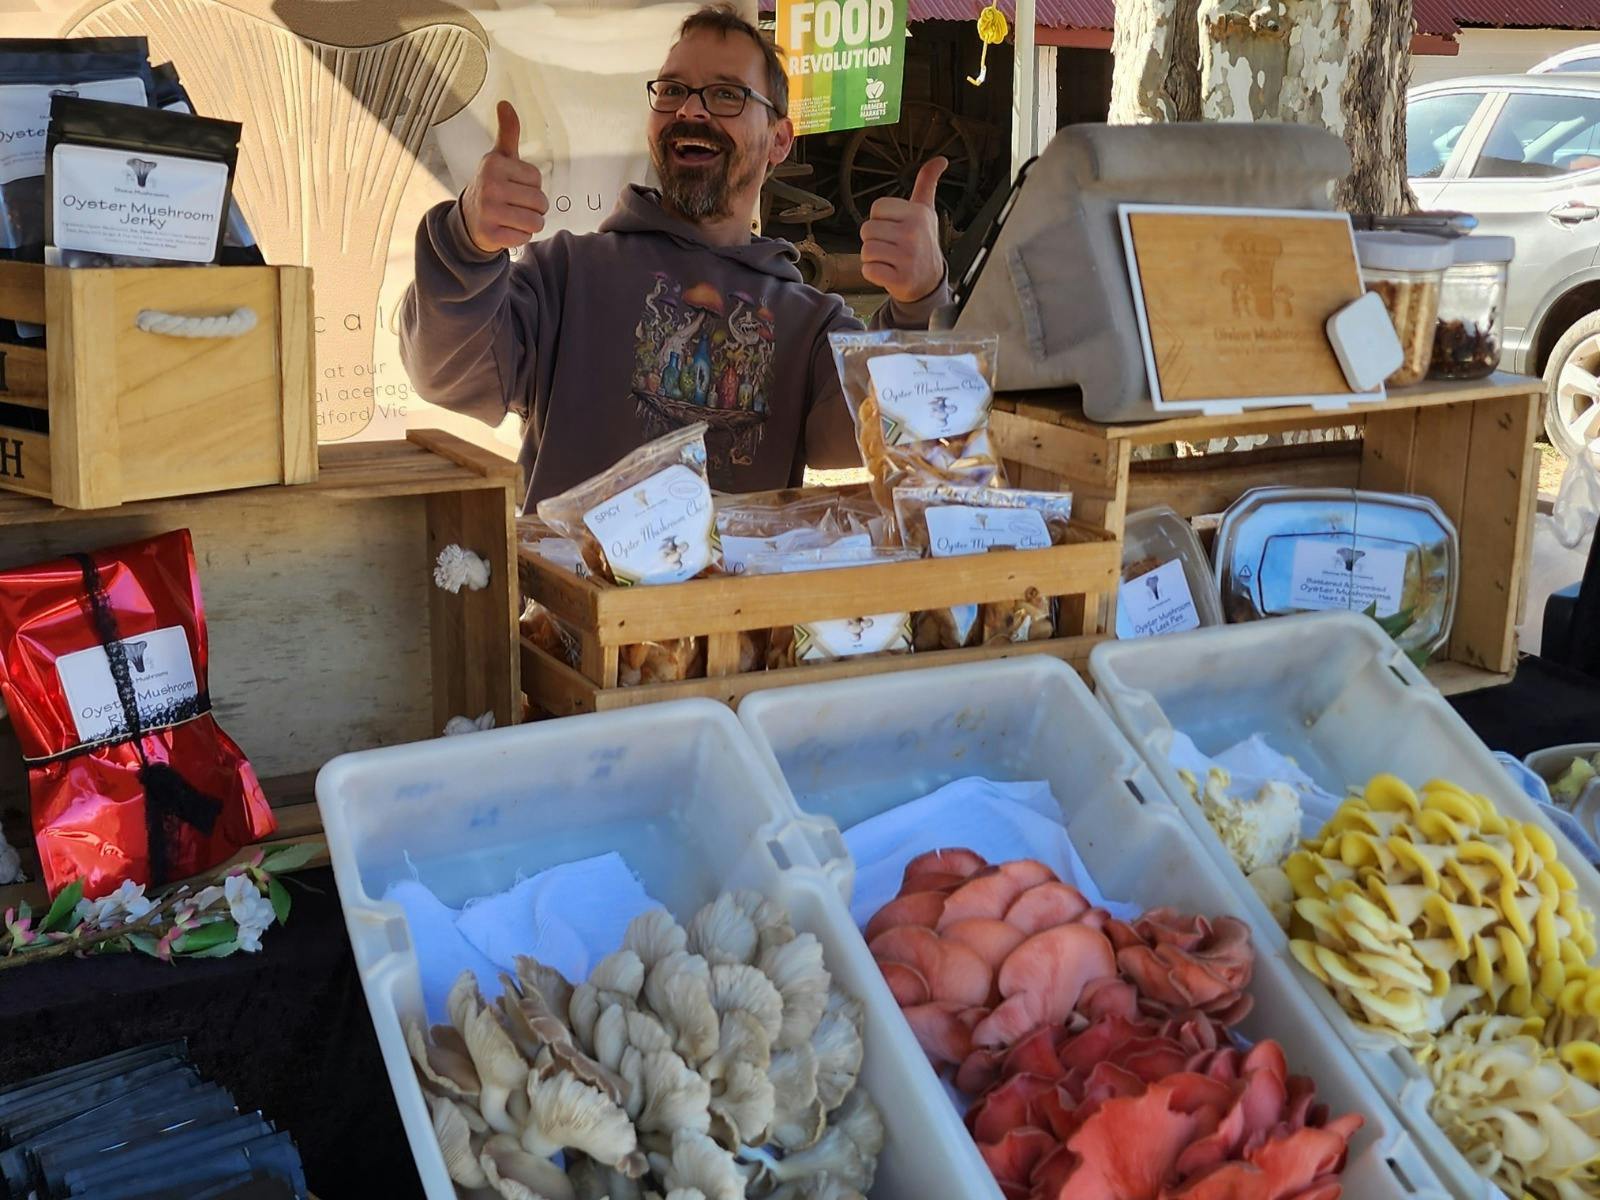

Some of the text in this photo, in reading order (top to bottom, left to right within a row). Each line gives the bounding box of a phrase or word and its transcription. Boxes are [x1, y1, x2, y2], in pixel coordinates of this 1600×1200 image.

[790, 0, 894, 49] FOOD
[789, 46, 892, 75] REVOLUTION
[860, 109, 886, 118] MARKETS
[0, 128, 46, 143] yste
[63, 194, 214, 222] Oyster Mushroom
[119, 213, 167, 230] Jerky
[324, 362, 387, 378] at our
[882, 387, 913, 403] Oyster
[378, 402, 408, 419] Vic
[595, 504, 621, 523] SPICY
[612, 540, 640, 558] Oyster
[937, 537, 968, 553] Oyster
[1300, 583, 1392, 601] Oyster Mushrooms
[1135, 617, 1158, 634] Oyster
[82, 679, 194, 720] Oyst Mushroom
[107, 701, 164, 727] Ritto
